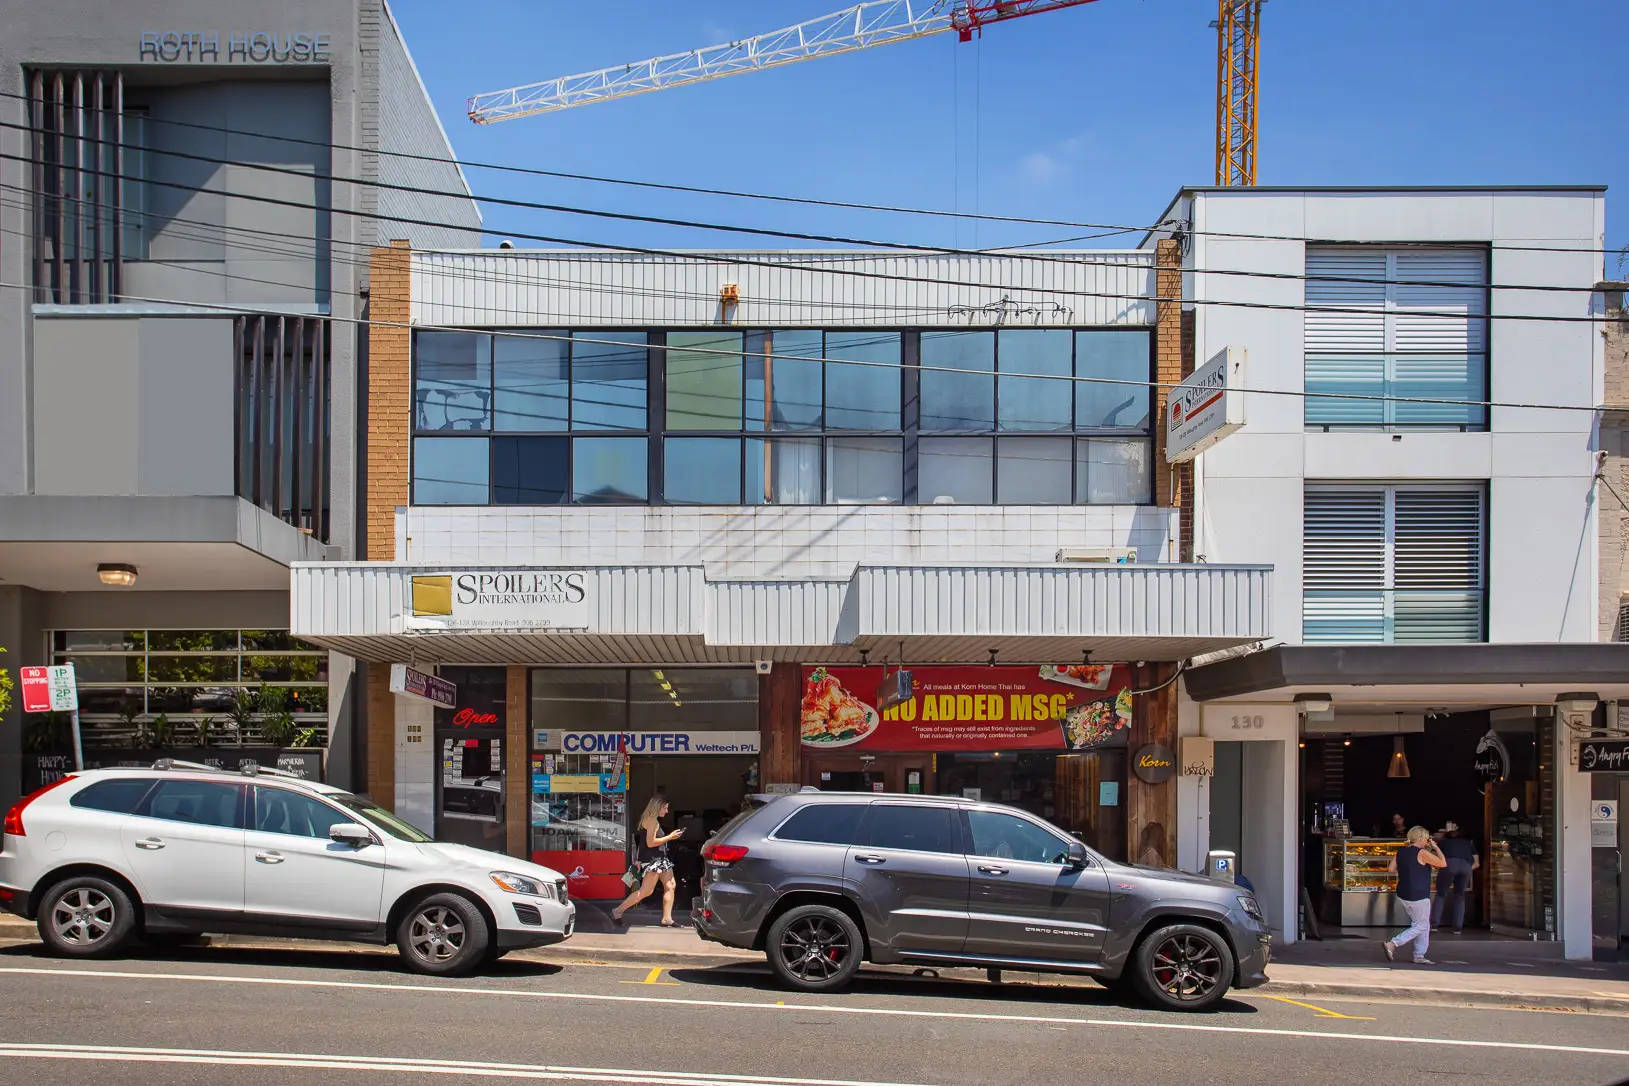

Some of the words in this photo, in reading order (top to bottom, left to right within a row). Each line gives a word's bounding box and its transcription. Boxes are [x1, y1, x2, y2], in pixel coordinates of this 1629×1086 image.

[139, 31, 219, 58] ROTH
[229, 31, 331, 58] HOUSE
[457, 573, 585, 604] SPOILERS
[479, 594, 564, 604] INTERNATIONAL
[29, 669, 40, 677] NO
[54, 668, 67, 677] 1P
[56, 689, 71, 697] 2P
[922, 694, 1003, 721] ADDED
[453, 708, 498, 728] Open
[1231, 715, 1264, 729] 130
[563, 733, 690, 752] COMPUTER
[695, 744, 738, 752] Weltech
[740, 744, 759, 752] P/L
[1139, 754, 1171, 768] Korn
[1218, 860, 1226, 869] P
